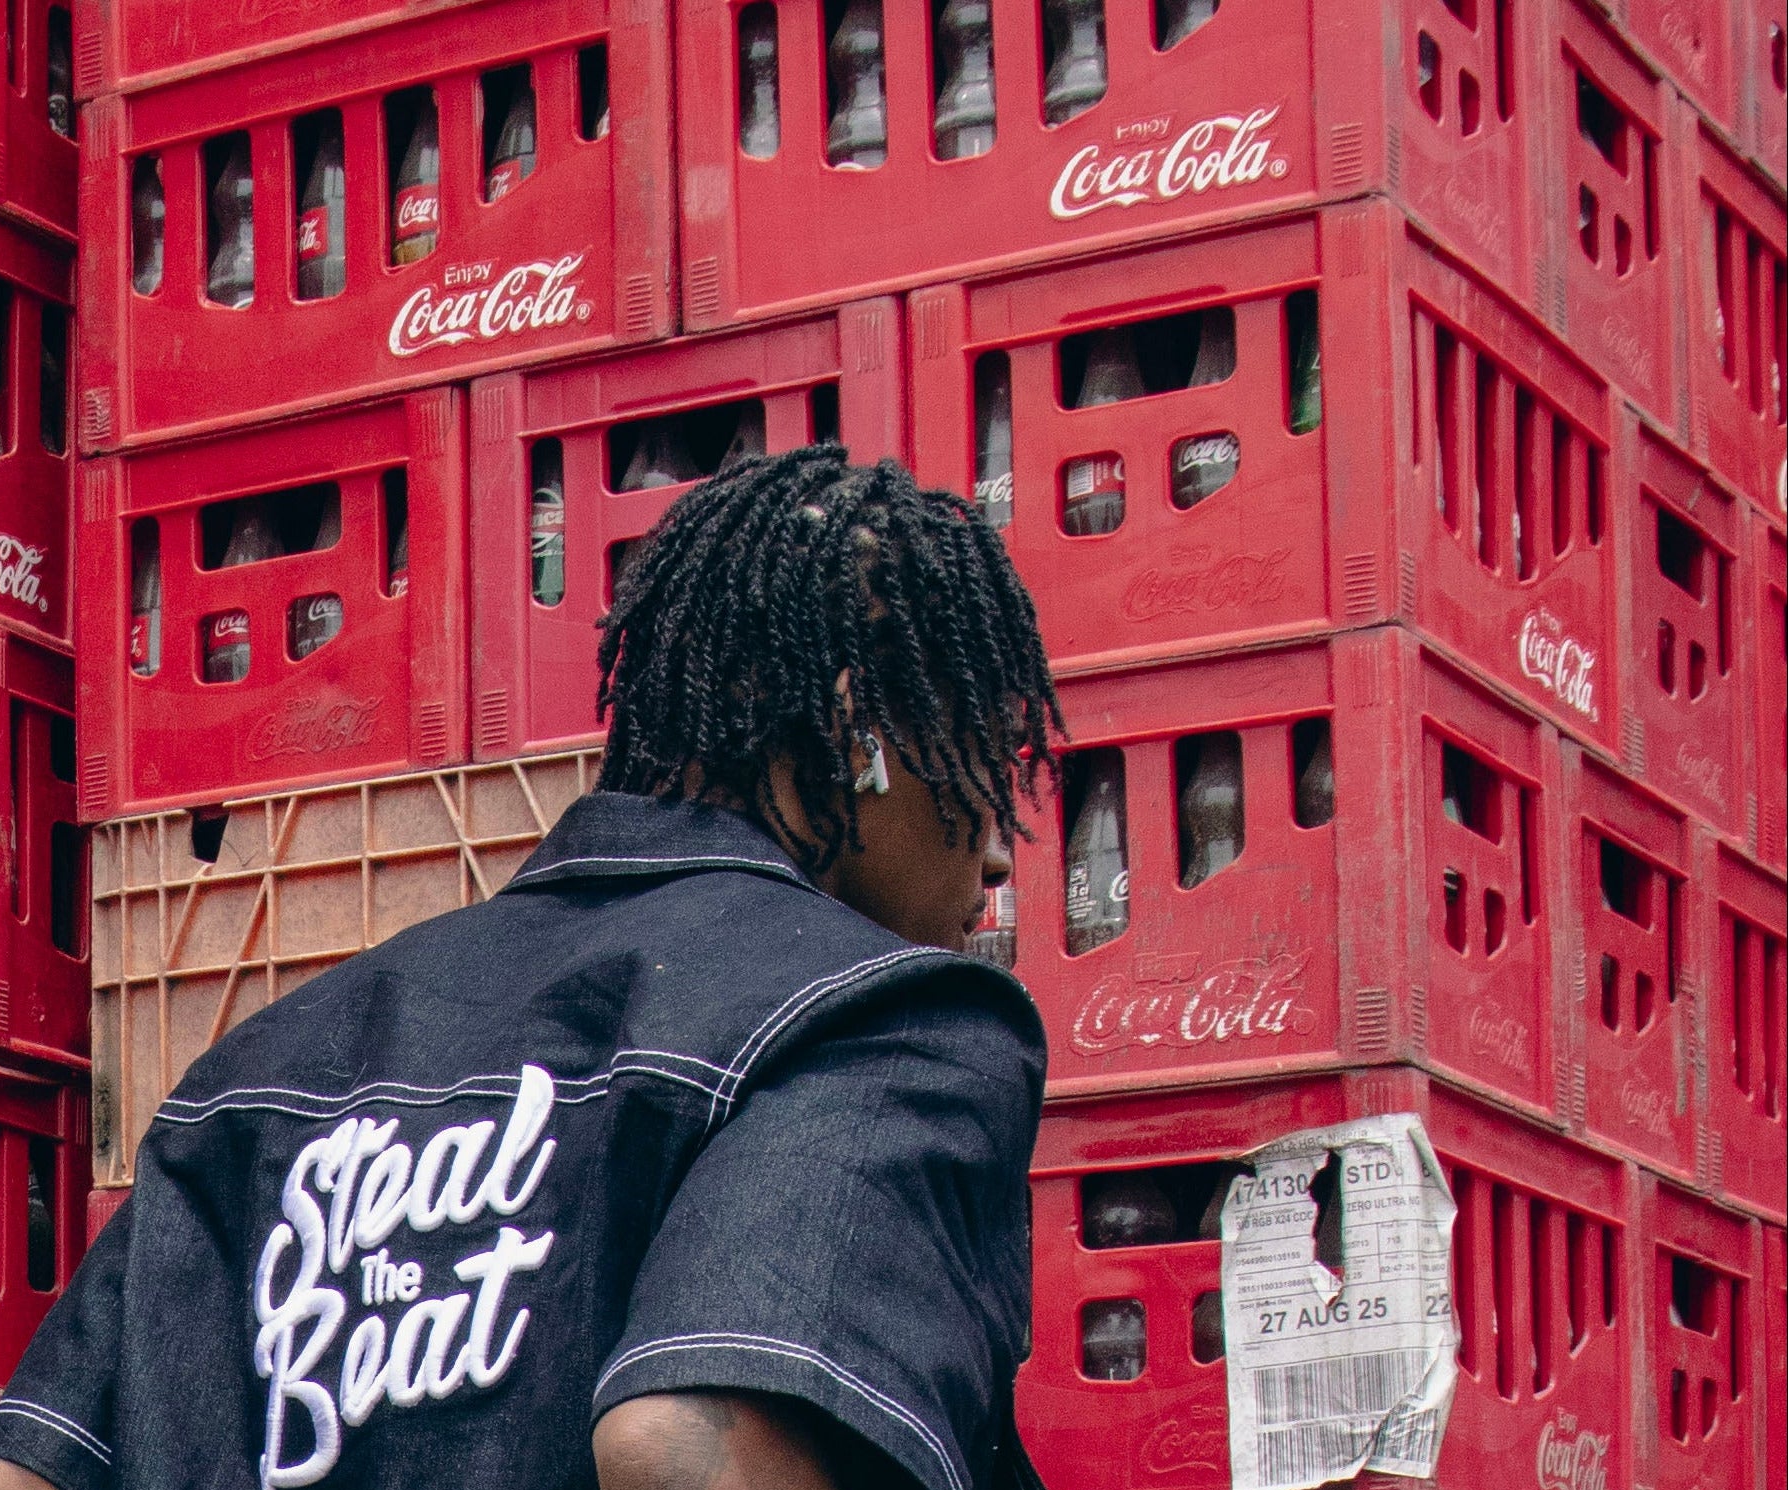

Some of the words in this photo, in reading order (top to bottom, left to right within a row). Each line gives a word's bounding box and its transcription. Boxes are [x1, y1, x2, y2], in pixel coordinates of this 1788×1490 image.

[1051, 107, 1280, 219] Coca-Cola
[445, 263, 490, 285] Enjoy
[390, 255, 580, 356] Coca-Cola
[1520, 617, 1595, 713] Coca-Cola
[256, 1064, 557, 1326] Steal
[1346, 1162, 1391, 1184] STD
[1347, 1200, 1372, 1213] ZERO
[361, 1248, 422, 1305] The
[1259, 1311, 1287, 1334] 27
[1296, 1302, 1349, 1330] AUG
[1358, 1296, 1387, 1321] 25
